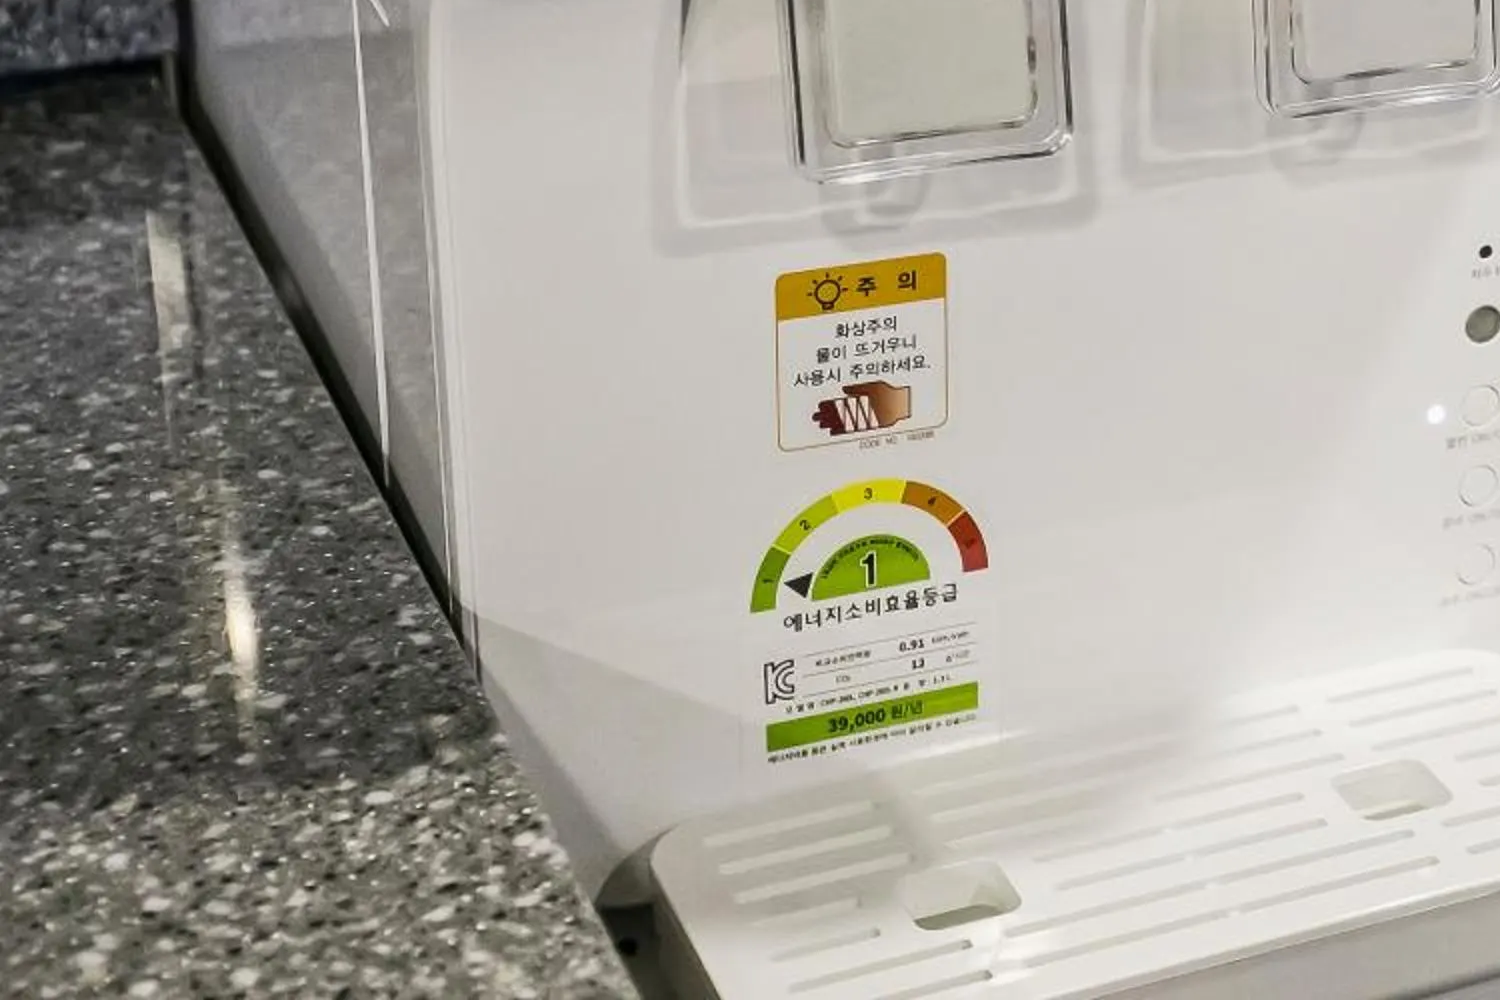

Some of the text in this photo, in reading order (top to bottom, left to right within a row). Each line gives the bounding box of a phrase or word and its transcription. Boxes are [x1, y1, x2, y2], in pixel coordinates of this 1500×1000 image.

[835, 315, 898, 339] 화상주의
[854, 334, 917, 357] 뜨거우니
[794, 355, 931, 387] 사용시 주의하세요.
[799, 519, 812, 531] 2
[863, 486, 873, 500] 3
[861, 551, 877, 586] 1
[783, 582, 958, 632] 에너지소비효율등급
[899, 638, 925, 652] 0.91
[827, 707, 886, 733] 39,000
